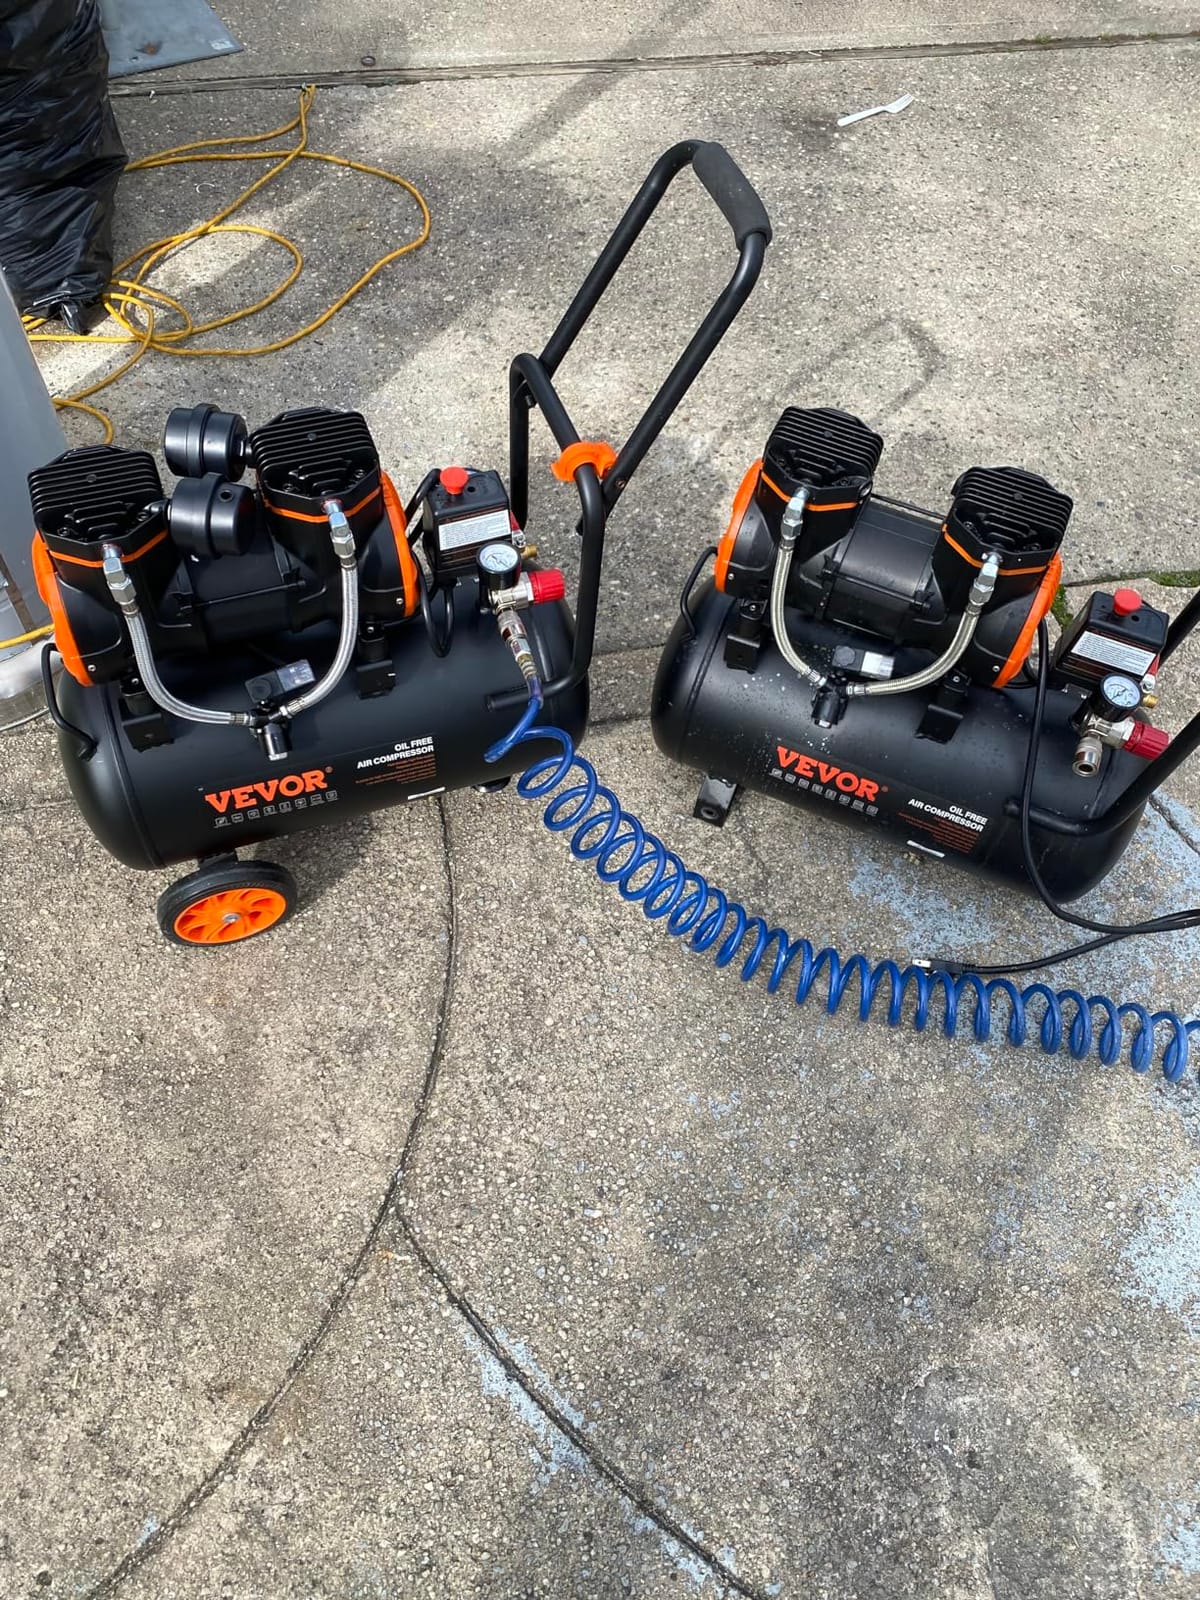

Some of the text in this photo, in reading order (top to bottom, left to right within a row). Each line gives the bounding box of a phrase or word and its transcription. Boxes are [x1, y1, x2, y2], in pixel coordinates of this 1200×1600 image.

[357, 759, 373, 769] AIR
[373, 745, 434, 765] COMPRESSOR
[394, 736, 433, 751] OIL FREE
[777, 745, 879, 802] VEVOR
[204, 769, 328, 813] VEVOR
[908, 798, 984, 832] AIR COMPRESSOR
[949, 805, 988, 825] OIL FREE
